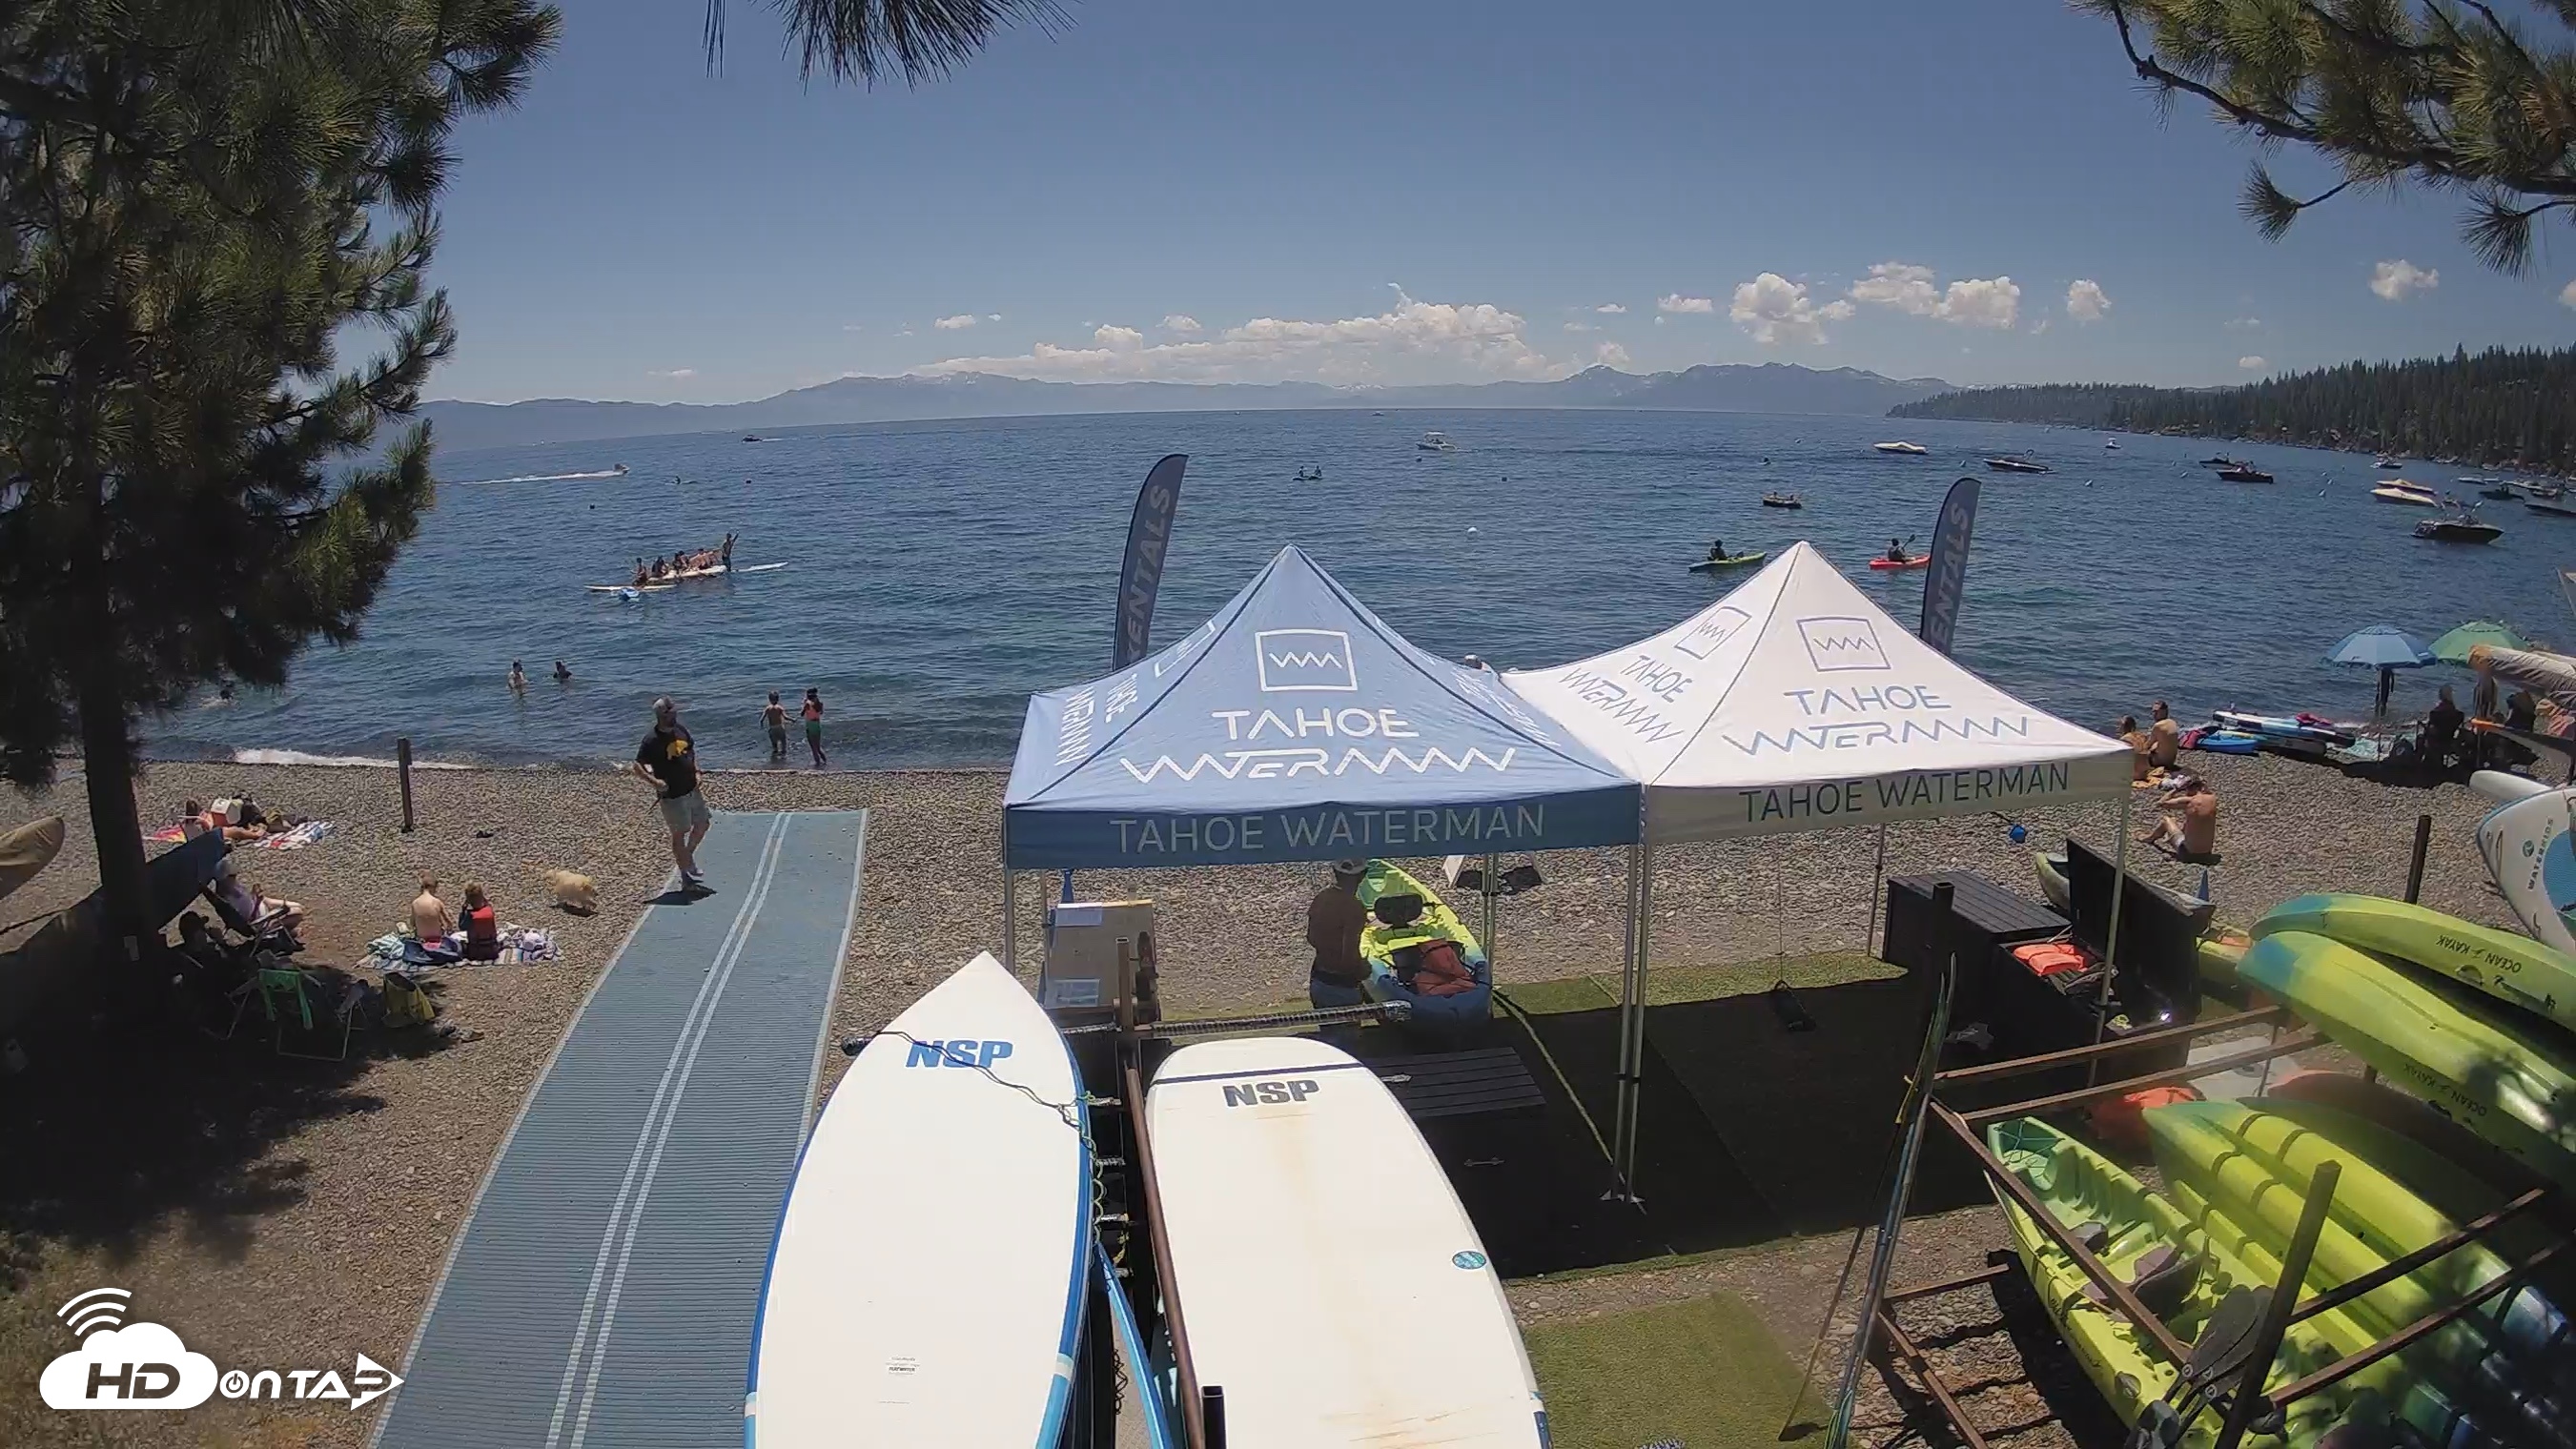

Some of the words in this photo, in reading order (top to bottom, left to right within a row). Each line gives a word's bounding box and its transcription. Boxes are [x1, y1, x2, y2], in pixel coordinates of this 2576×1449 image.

[1930, 501, 1969, 644] ENTALS
[1621, 655, 1692, 703] TAHOE
[1783, 684, 1952, 717] TAHOE
[1212, 708, 1420, 741] TAHOE
[1739, 779, 1863, 823] TAHOE
[1876, 762, 2070, 808] WATERMAN
[1110, 816, 1263, 854] TAHOE
[1281, 804, 1544, 849] WATERMAN
[2435, 934, 2471, 954] KAYAK
[2484, 952, 2523, 973] OCEAN
[906, 1040, 1013, 1068] NSP
[1222, 1079, 1319, 1107] NSP
